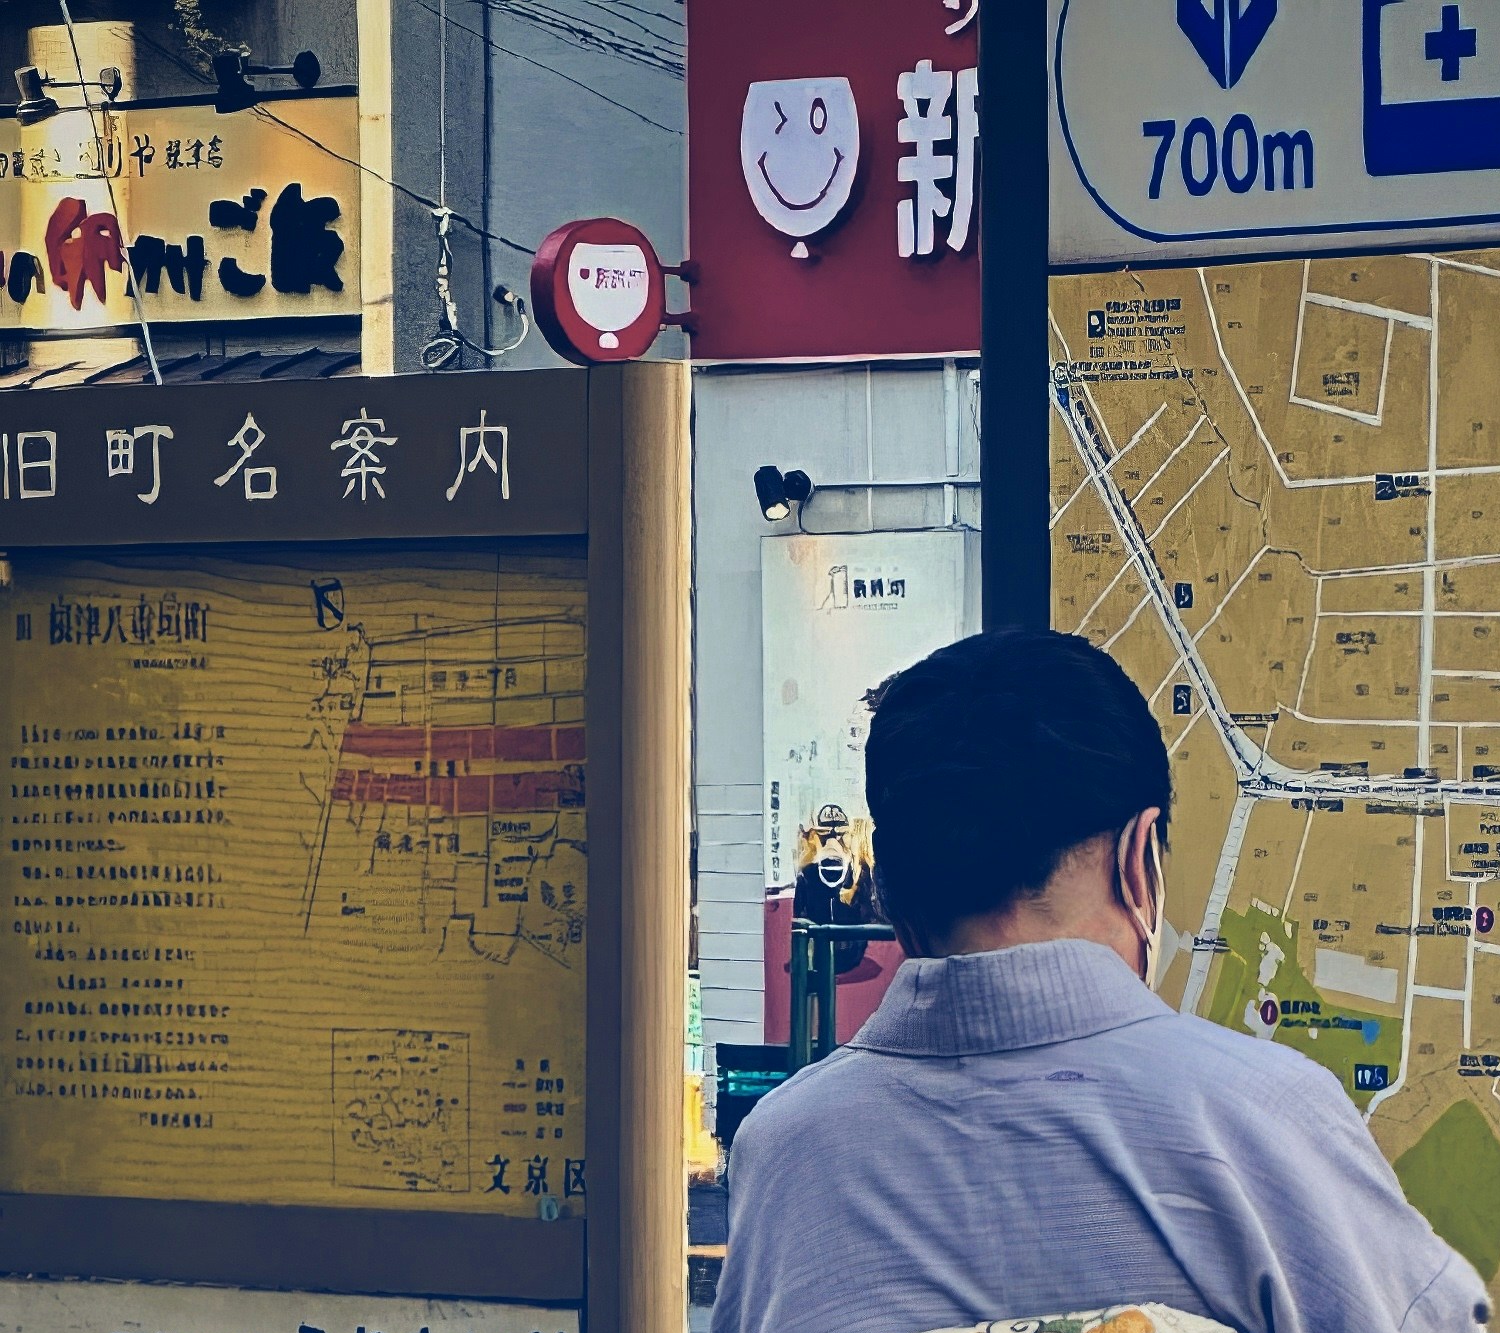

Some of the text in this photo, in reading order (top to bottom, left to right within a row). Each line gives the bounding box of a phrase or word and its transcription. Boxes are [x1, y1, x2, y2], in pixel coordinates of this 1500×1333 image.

[1143, 114, 1313, 199] 700m
[2, 407, 510, 504] 旧町名案内
